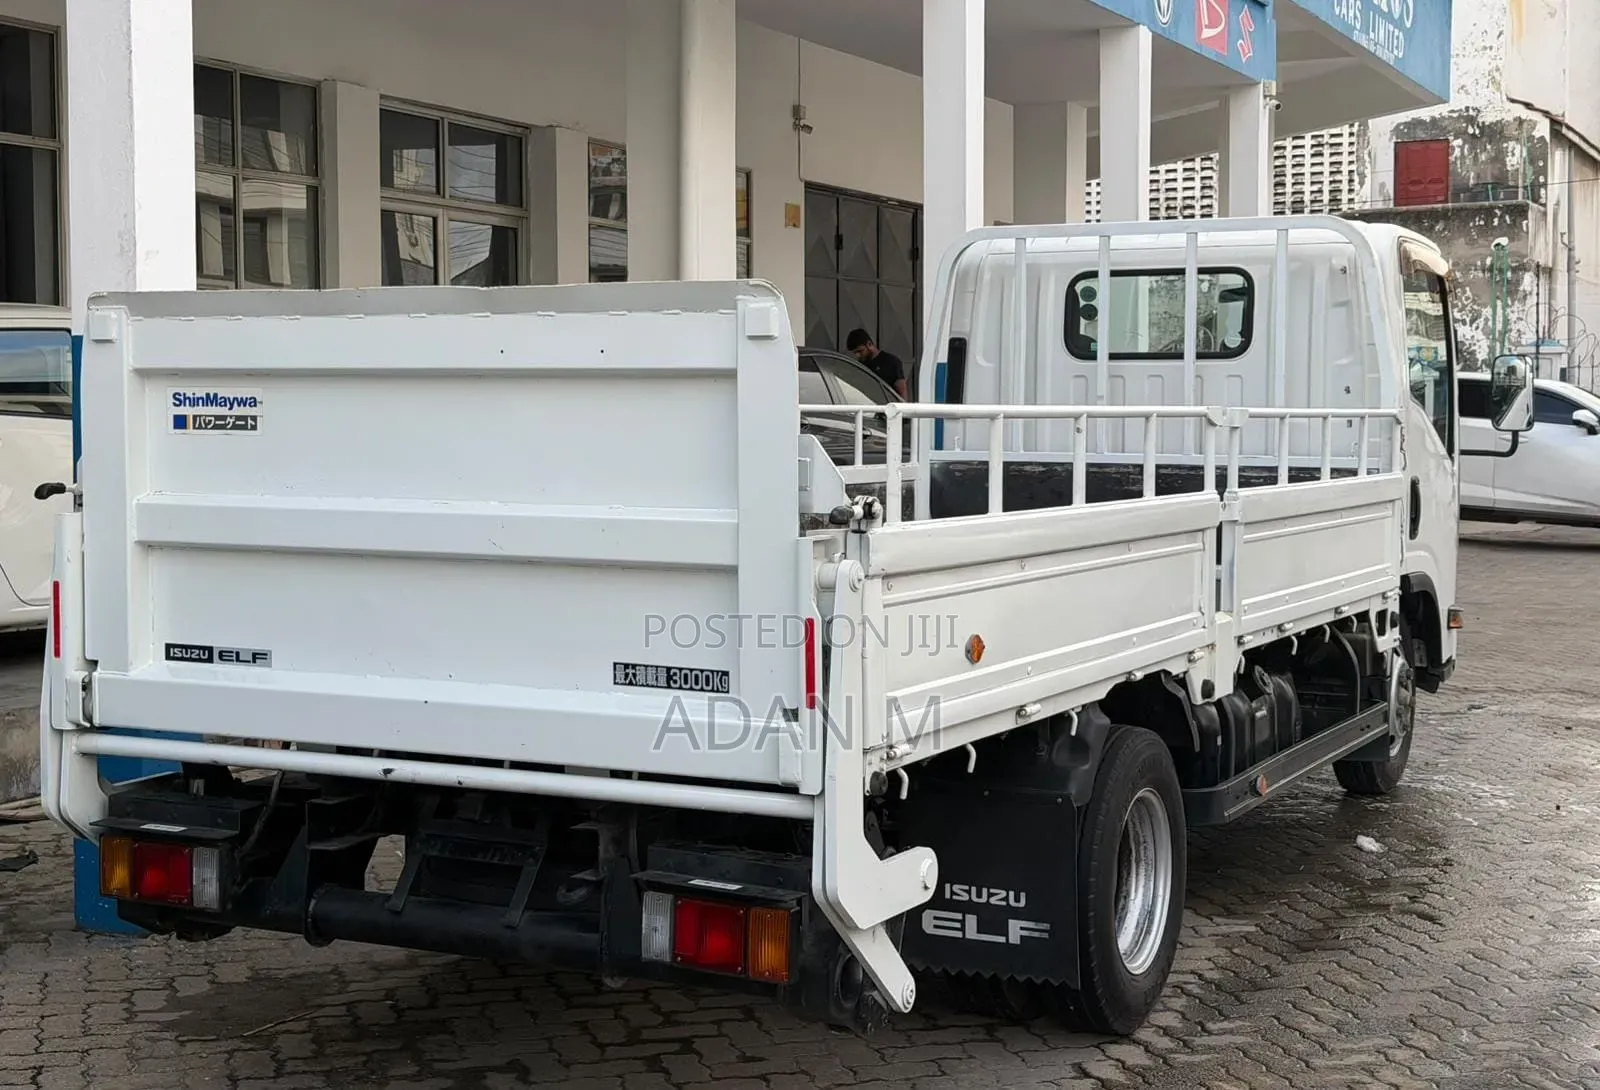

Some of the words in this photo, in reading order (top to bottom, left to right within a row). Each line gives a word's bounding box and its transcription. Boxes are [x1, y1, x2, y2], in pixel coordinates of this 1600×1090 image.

[1334, 0, 1362, 30] CARS
[1369, 10, 1404, 59] LIMITED
[172, 391, 257, 410] ShinMaywa
[195, 416, 256, 429] パワーゲート
[170, 647, 208, 659] ISUZU
[218, 649, 268, 664] ELF
[615, 664, 668, 687] 最大積載量
[944, 883, 1026, 908] ISUZU
[922, 908, 1050, 945] ELF
